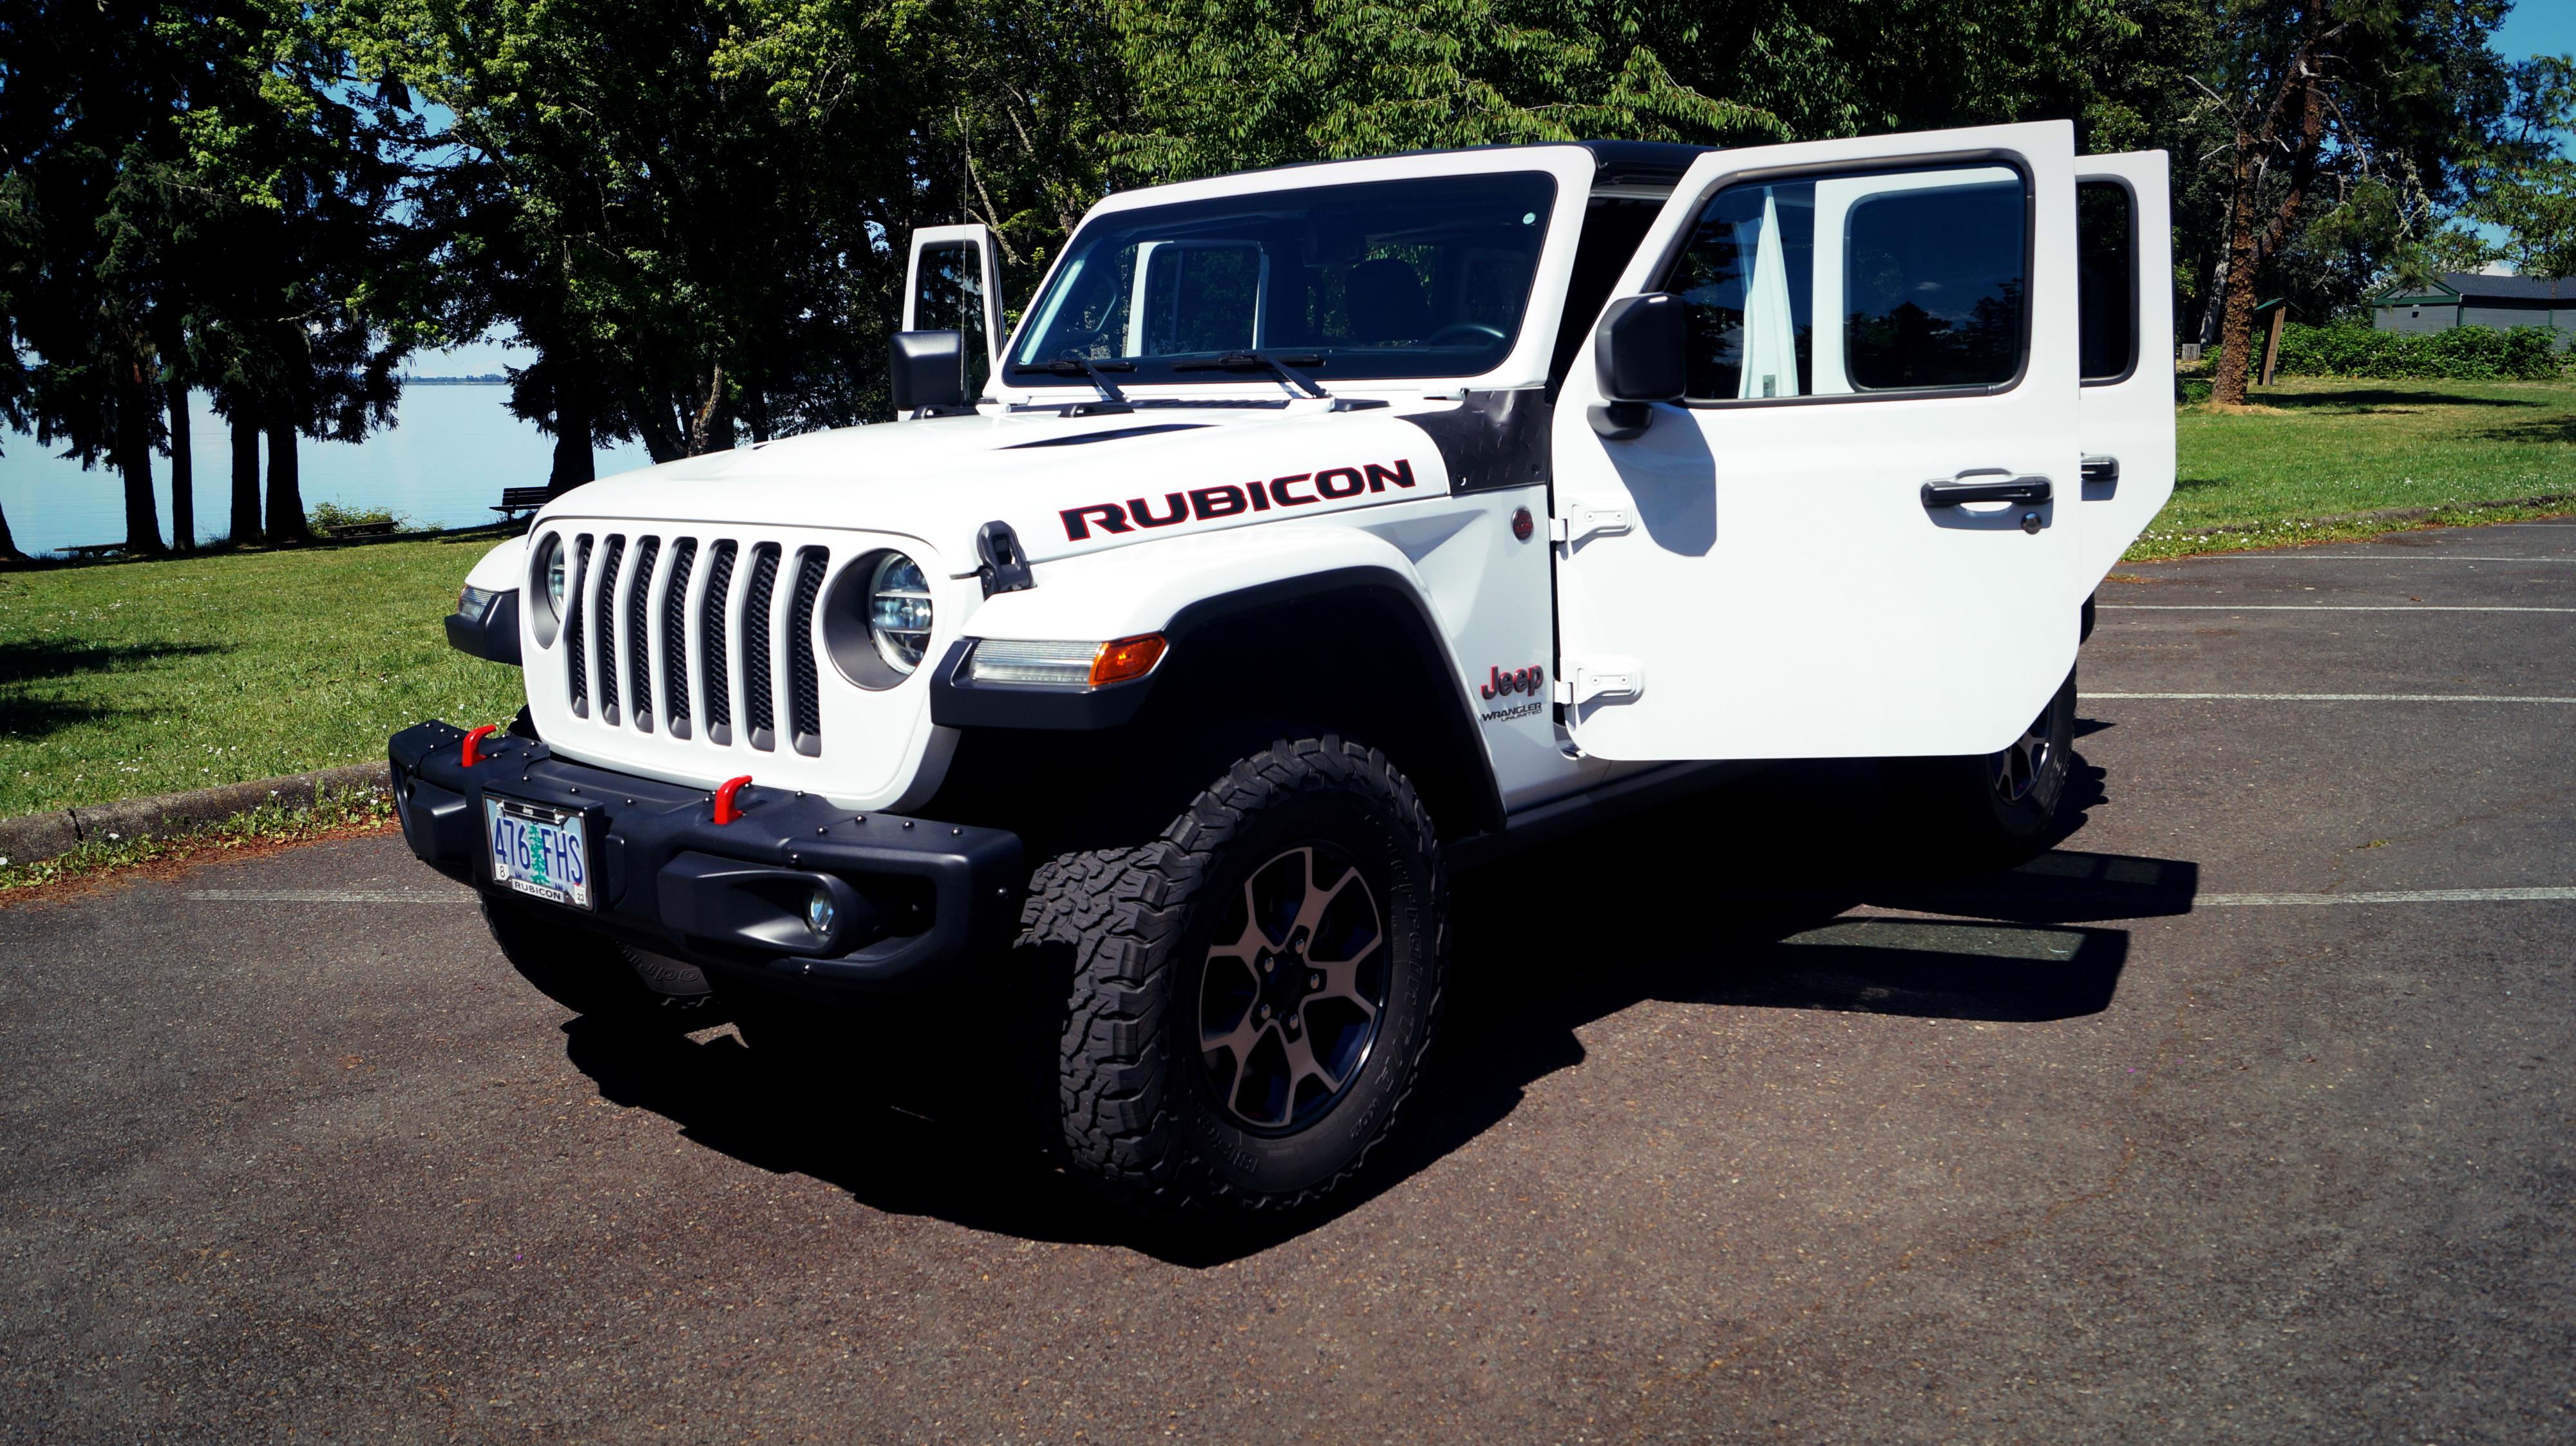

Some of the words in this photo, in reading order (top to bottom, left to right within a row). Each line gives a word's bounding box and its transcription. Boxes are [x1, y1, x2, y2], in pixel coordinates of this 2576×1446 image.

[1059, 459, 1416, 541] RUBICON
[1481, 664, 1544, 700] Jeep
[1482, 702, 1542, 722] WRANGLER
[1501, 709, 1542, 722] UNLIMITED
[495, 817, 531, 870] 476
[540, 828, 583, 883] FHS
[500, 865, 506, 878] 8
[515, 881, 561, 900] RUBICON
[576, 893, 585, 902] 23
